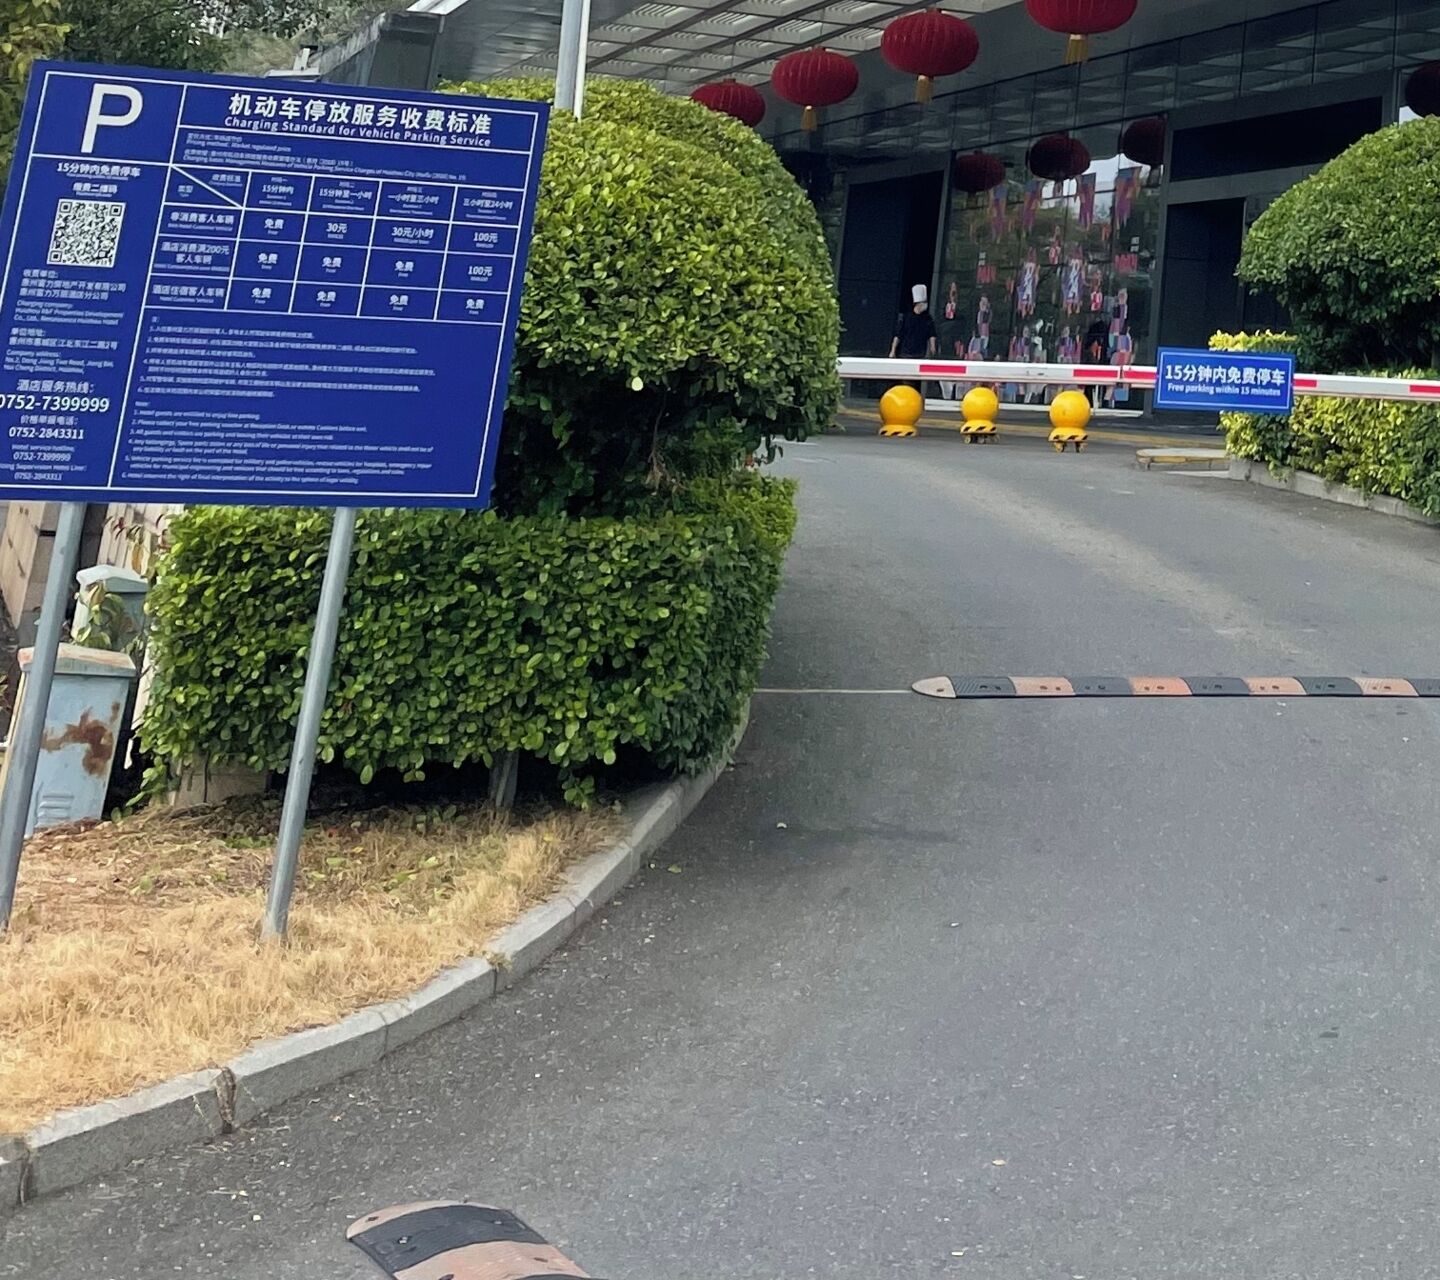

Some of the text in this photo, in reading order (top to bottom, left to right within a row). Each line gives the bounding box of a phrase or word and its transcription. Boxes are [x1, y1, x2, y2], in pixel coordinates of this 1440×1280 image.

[81, 83, 143, 153] P
[229, 92, 492, 136] 机动车停放服务收费标准
[224, 116, 491, 147] Charging Standard for Vehicle Parking Service
[56, 162, 141, 177] 15分钟内免费停车
[264, 219, 284, 230] 免费
[327, 222, 348, 234] 30元
[391, 227, 434, 239] 30元/小时
[473, 232, 499, 243] 100元
[258, 253, 278, 265] 免费
[322, 257, 342, 268] 免费
[395, 261, 414, 272] 免费
[468, 265, 493, 277] 100元
[251, 287, 272, 299] 免费
[317, 291, 337, 302] 免费
[389, 295, 409, 306] 免费
[465, 299, 485, 310] 免费
[1165, 364, 1286, 386] 15分钟内免费停车
[1168, 382, 1281, 397] Free parking within 15 minutes
[0, 393, 110, 412] 0752-7399999
[9, 427, 84, 440] 0752-2843311
